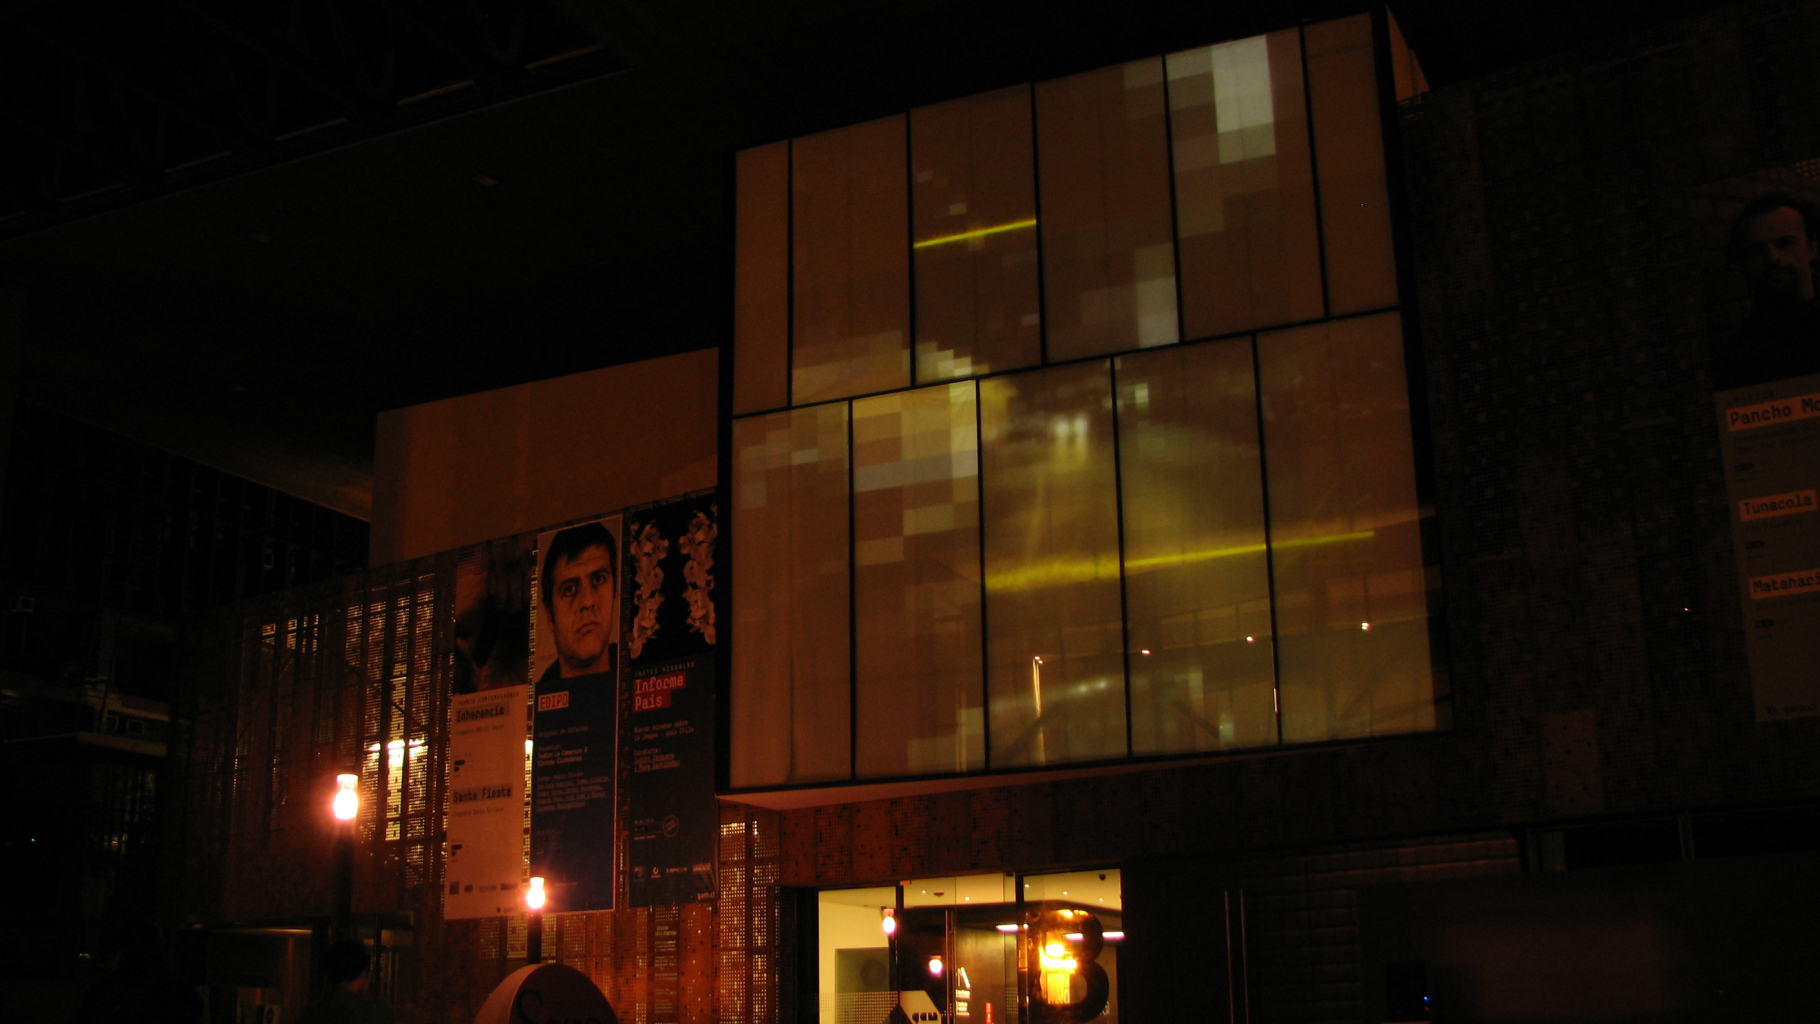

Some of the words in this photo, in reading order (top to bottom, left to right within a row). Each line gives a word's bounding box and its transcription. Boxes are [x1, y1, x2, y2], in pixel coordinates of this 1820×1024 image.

[1731, 405, 1792, 426] Pancho
[1743, 494, 1812, 514] Tunacola
[635, 675, 684, 694] Informe
[540, 693, 568, 710] EDIPO
[635, 693, 662, 711] País
[457, 704, 504, 722] Inherencia
[453, 790, 477, 803] Santa
[482, 787, 512, 799] Fiesta
